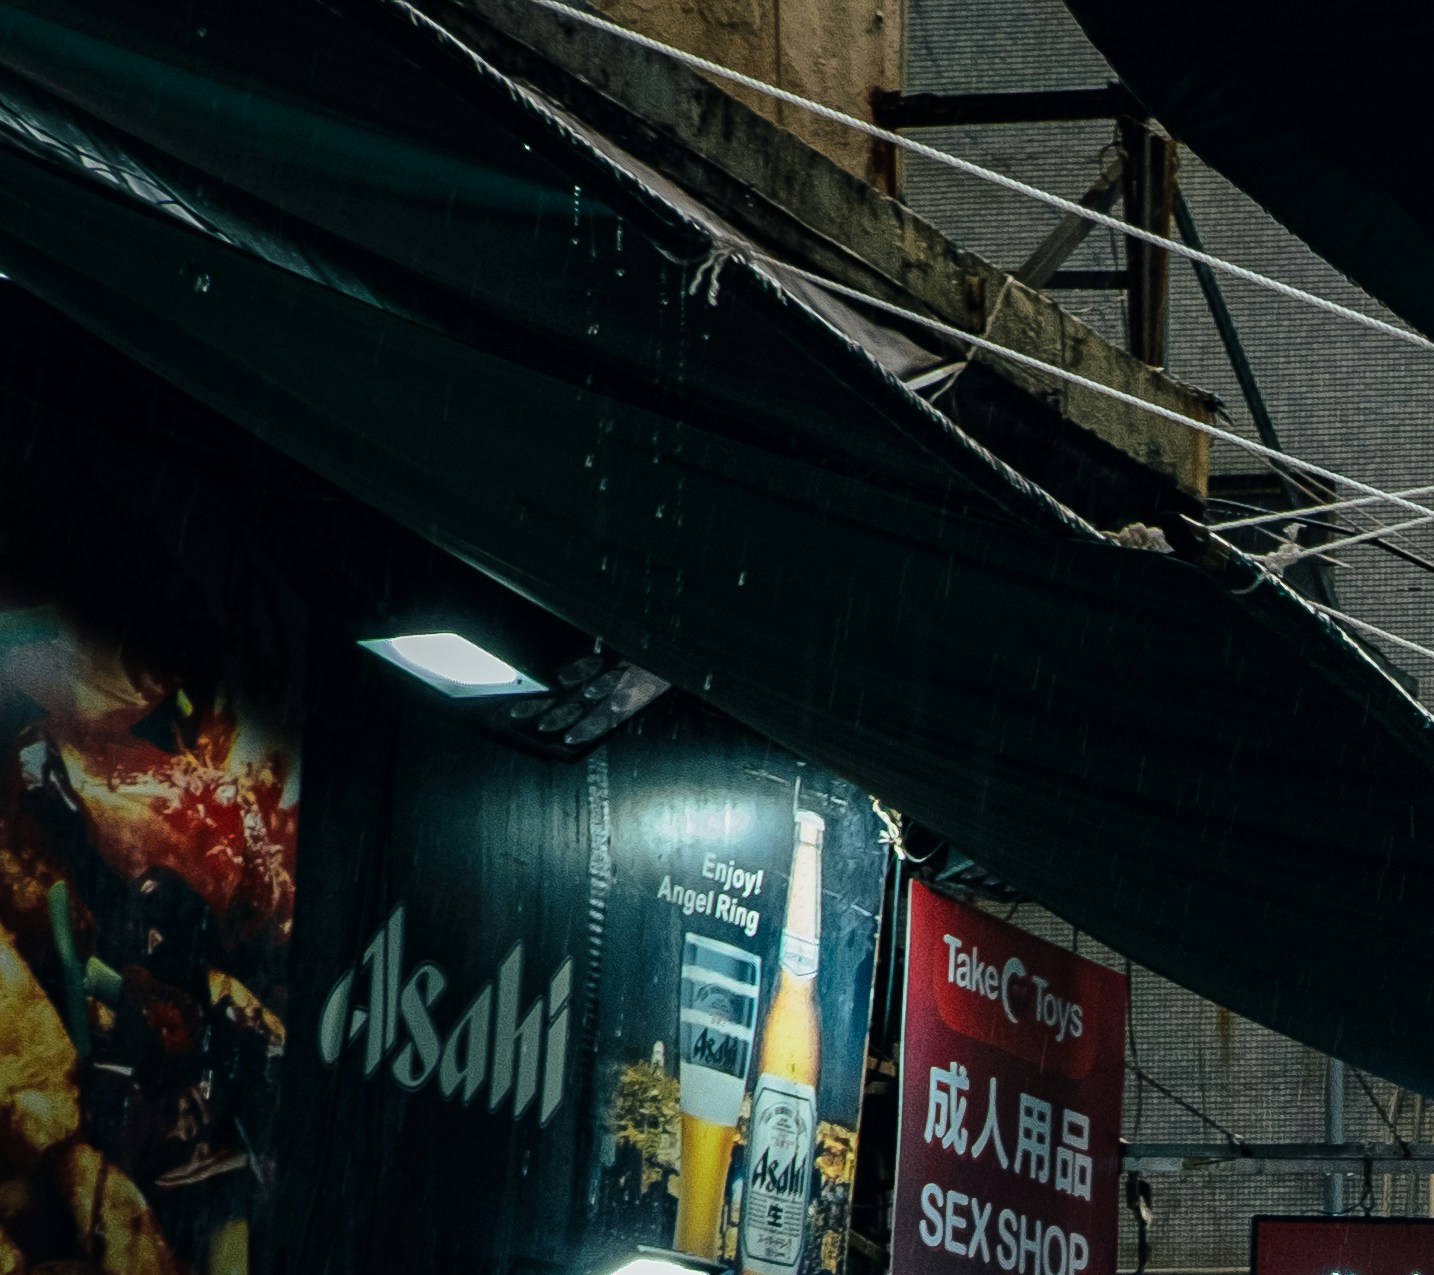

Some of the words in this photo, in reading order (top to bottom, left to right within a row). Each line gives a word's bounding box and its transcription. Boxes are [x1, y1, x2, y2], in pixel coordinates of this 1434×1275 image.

[657, 875, 715, 916] Angel
[715, 893, 760, 936] Ring
[702, 852, 764, 897] Enjoy!
[318, 903, 576, 1127] Asahi
[944, 934, 998, 1001] Take
[1032, 976, 1084, 1042] Toys
[924, 1061, 1093, 1201] 成人用品
[752, 1147, 808, 1199] Asahi
[767, 1204, 784, 1228] 生
[918, 1182, 992, 1264] SEX
